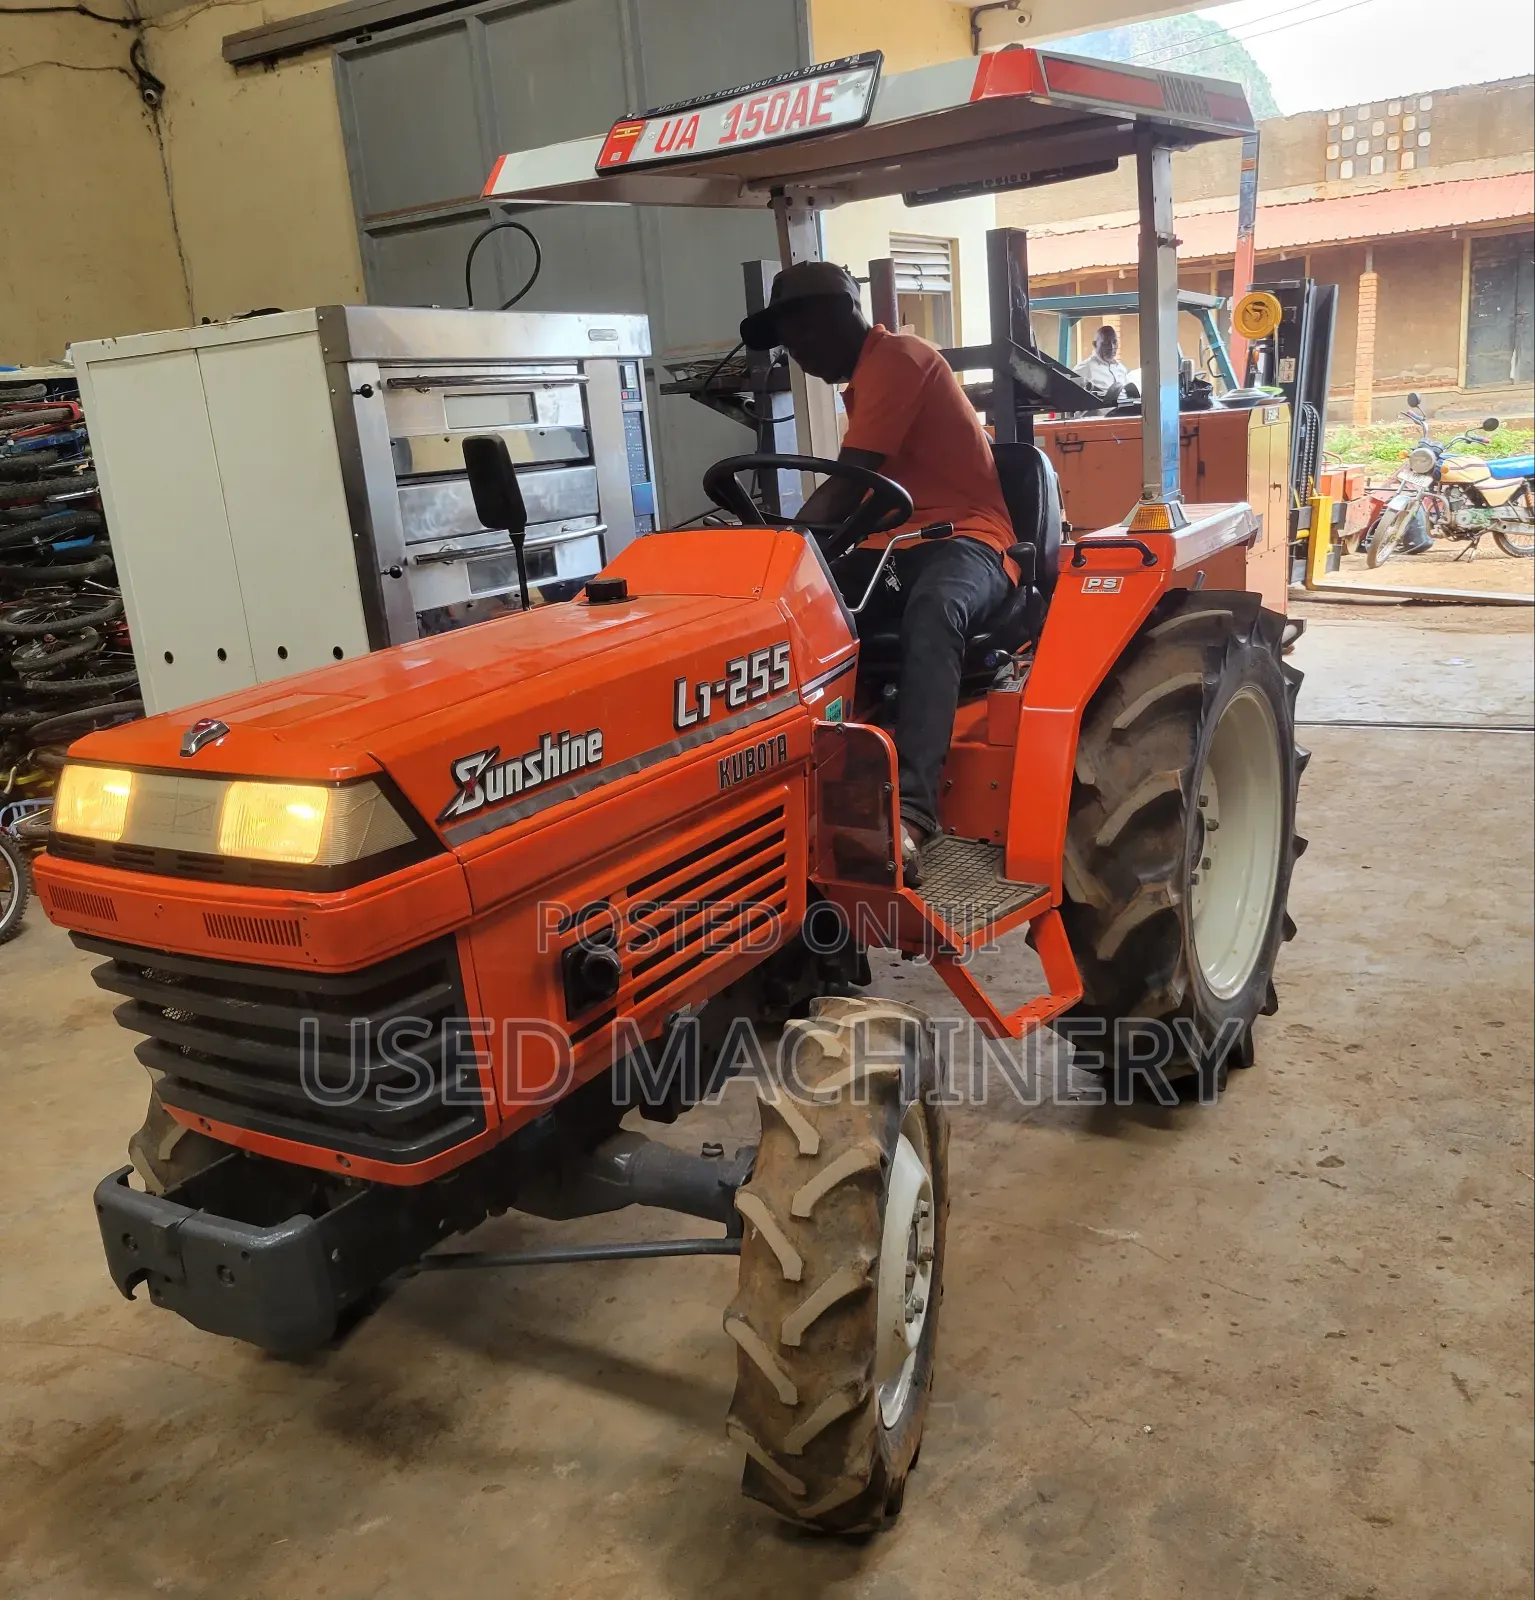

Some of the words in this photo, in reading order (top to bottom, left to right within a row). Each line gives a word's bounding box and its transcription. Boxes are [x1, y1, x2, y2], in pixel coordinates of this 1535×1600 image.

[776, 70, 799, 82] Safe
[802, 61, 836, 75] Space
[653, 113, 700, 154] UA
[717, 79, 839, 145] 150AE
[1087, 578, 1118, 590] PS
[435, 727, 603, 824] Sunshine
[717, 732, 788, 791] KUBOTA
